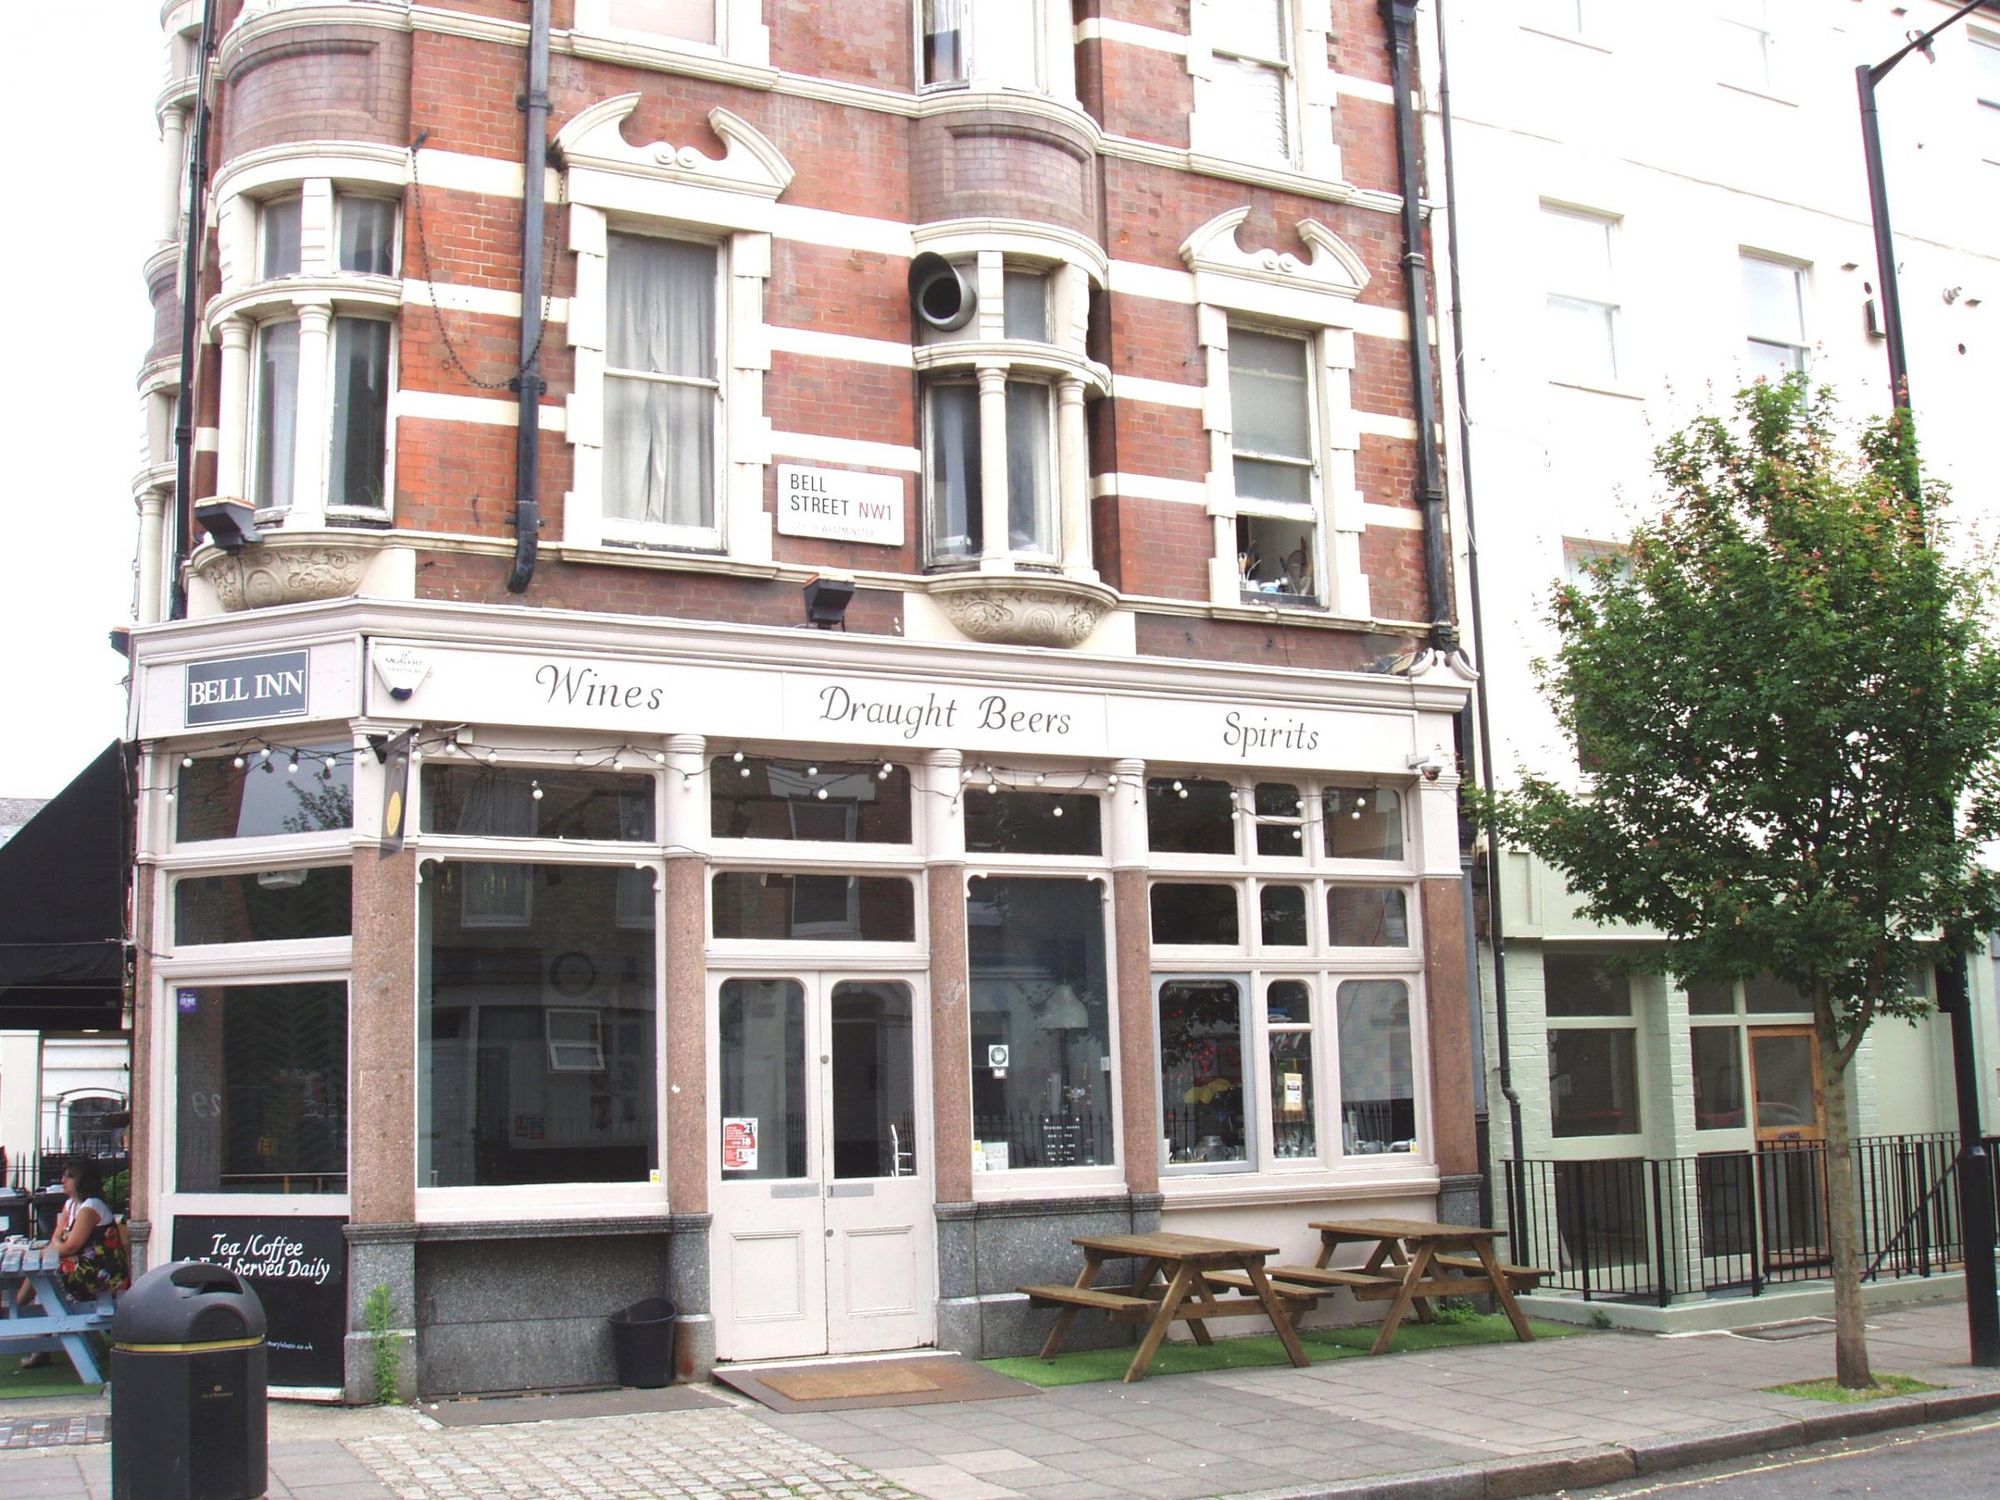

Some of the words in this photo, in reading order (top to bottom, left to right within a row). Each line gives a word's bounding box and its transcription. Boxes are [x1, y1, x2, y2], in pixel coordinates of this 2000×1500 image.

[790, 473, 827, 493] BELL
[790, 495, 849, 516] STREET
[859, 501, 892, 521] NW1
[189, 677, 250, 706] BELL
[254, 669, 304, 699] INN
[535, 663, 664, 711] Wines
[819, 685, 957, 739] Draught
[978, 695, 1072, 736] Beers
[1223, 711, 1320, 758] Spirits
[210, 1233, 241, 1256] Tea
[234, 1256, 285, 1277] Served
[287, 1257, 331, 1285] Daily
